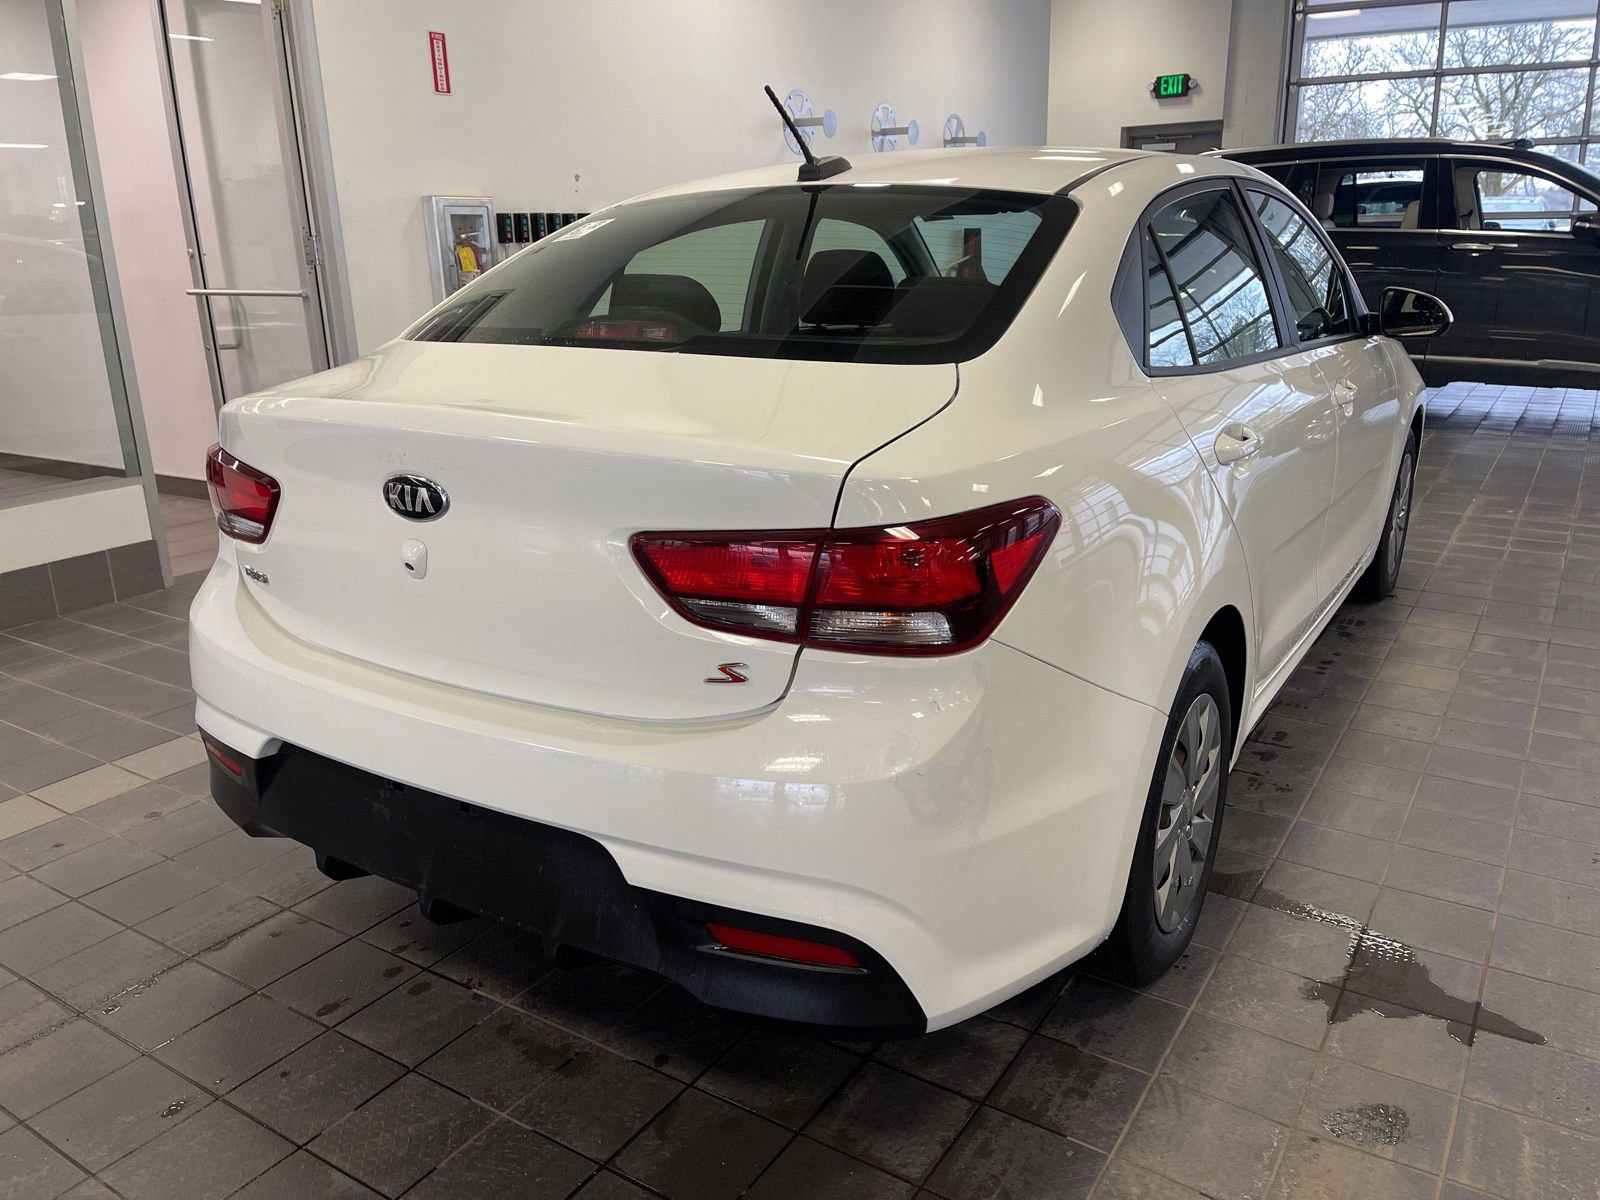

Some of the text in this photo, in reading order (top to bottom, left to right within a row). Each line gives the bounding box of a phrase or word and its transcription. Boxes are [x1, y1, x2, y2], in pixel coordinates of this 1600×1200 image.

[1160, 75, 1184, 95] EXIT
[388, 483, 435, 513] KIA
[703, 662, 749, 684] S
